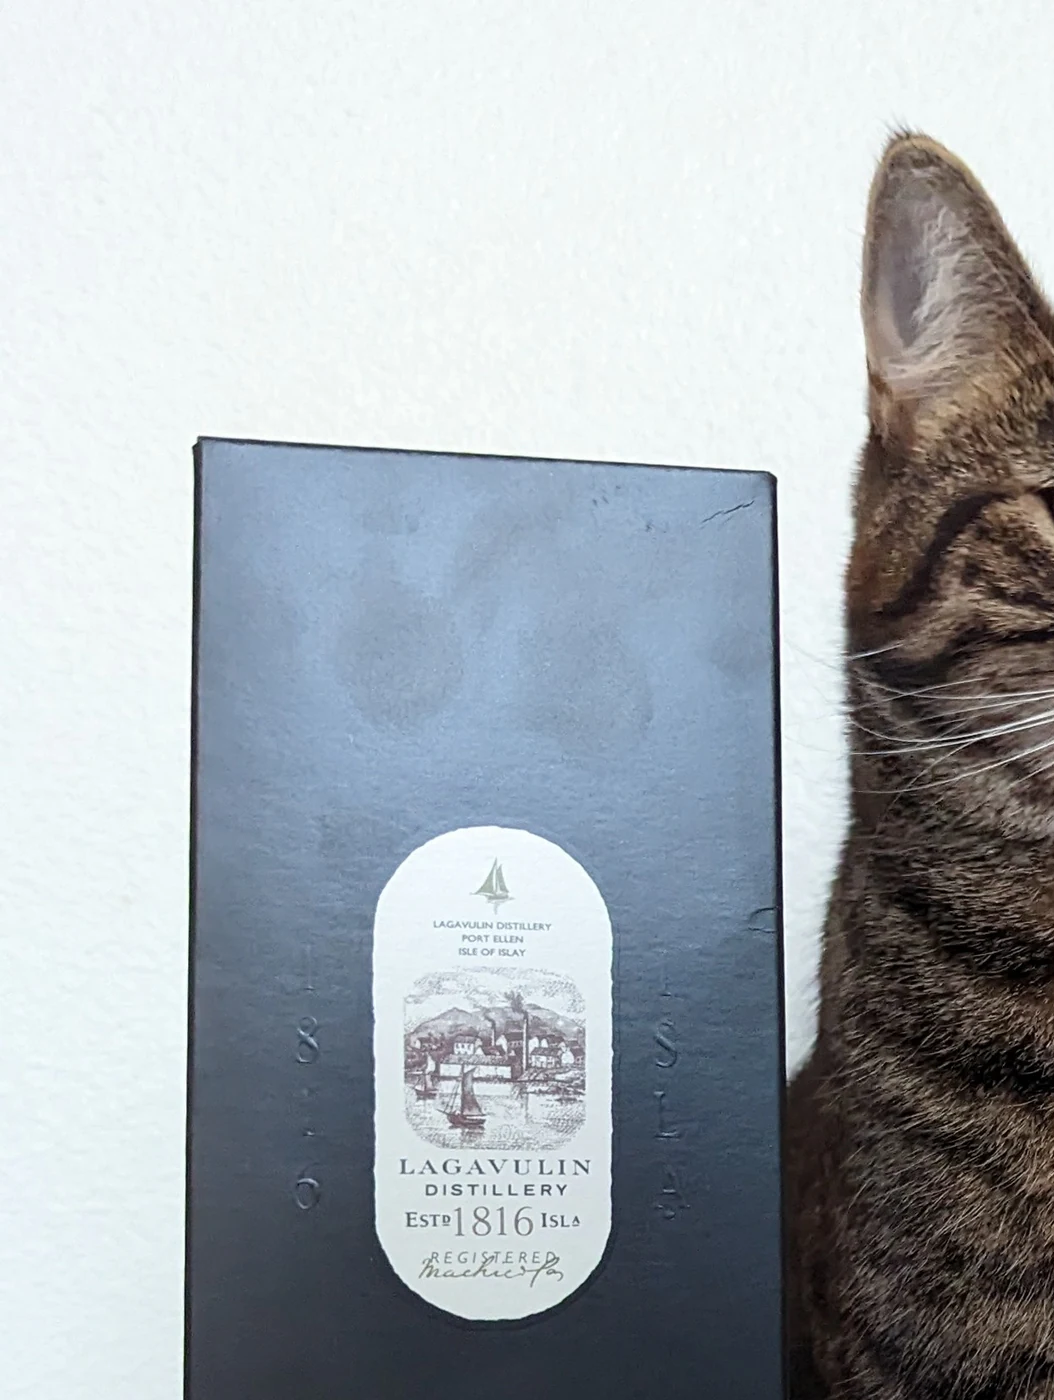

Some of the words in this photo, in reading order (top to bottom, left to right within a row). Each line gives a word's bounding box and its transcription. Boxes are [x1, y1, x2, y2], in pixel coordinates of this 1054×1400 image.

[433, 920, 493, 930] LAGAVULIN
[496, 921, 552, 931] DISTILLERY
[461, 934, 489, 943] PORT
[493, 935, 524, 944] ELLEN
[458, 948, 478, 957] ISLE
[480, 948, 495, 957] OF
[498, 949, 526, 957] ISLAY
[400, 1159, 591, 1175] LAGAVULIN
[425, 1184, 568, 1197] DISTILLERY
[454, 1206, 534, 1237] 1816
